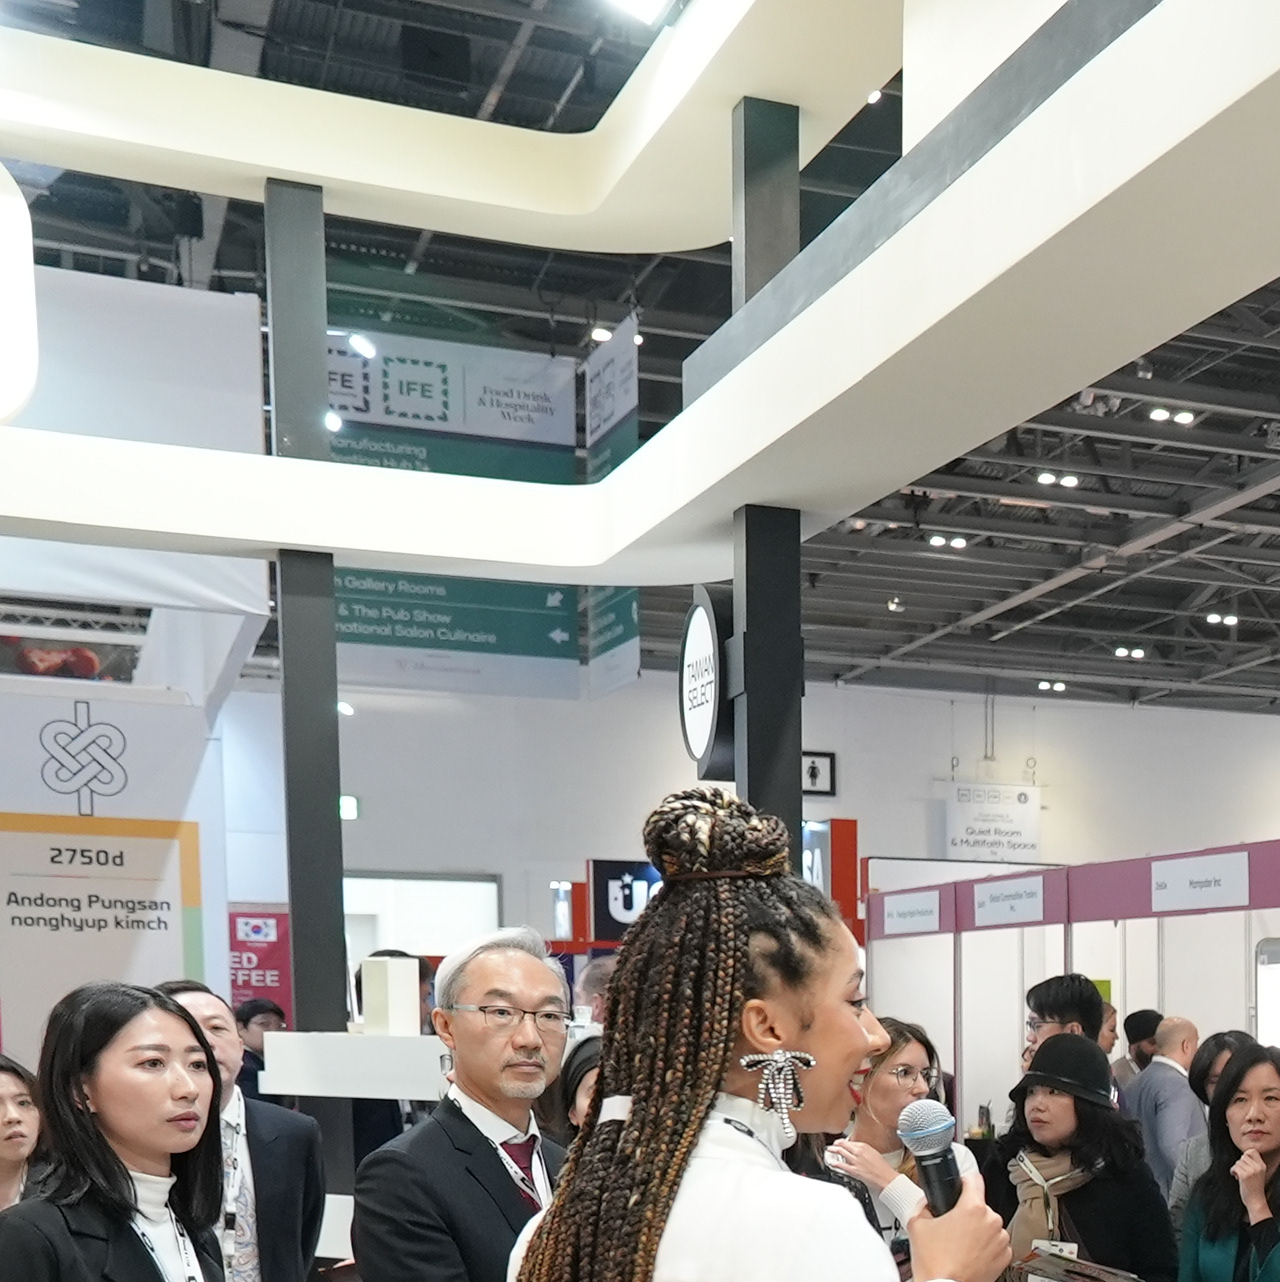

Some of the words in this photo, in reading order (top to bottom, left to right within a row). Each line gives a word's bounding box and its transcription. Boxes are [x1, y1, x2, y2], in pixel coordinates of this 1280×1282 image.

[328, 371, 354, 390] FE
[399, 380, 434, 399] IFE
[482, 386, 515, 399] Food
[516, 389, 551, 403] Drink
[487, 397, 555, 416] Hospitality
[501, 409, 536, 424] Week
[330, 437, 427, 460] anufacturing
[347, 577, 397, 595] Gallery
[398, 581, 447, 596] Rooms
[338, 604, 349, 616] &
[351, 604, 380, 619] The
[382, 607, 412, 621] Pub
[413, 610, 452, 624] Show
[335, 621, 393, 637] national
[395, 625, 435, 640] Salon
[437, 627, 498, 644] Culinaire
[688, 679, 714, 711] SELECT
[965, 827, 991, 836] Quiet
[994, 828, 1022, 837] Room
[960, 839, 1004, 849] Multifaith
[1006, 840, 1037, 850] Space
[49, 847, 125, 867] 2750d
[7, 892, 82, 912] Andong
[87, 895, 171, 914] Pungsan
[11, 914, 108, 932] nonghyup
[114, 916, 168, 931] kimch
[230, 951, 258, 969] ED
[230, 969, 280, 987] FFEE
